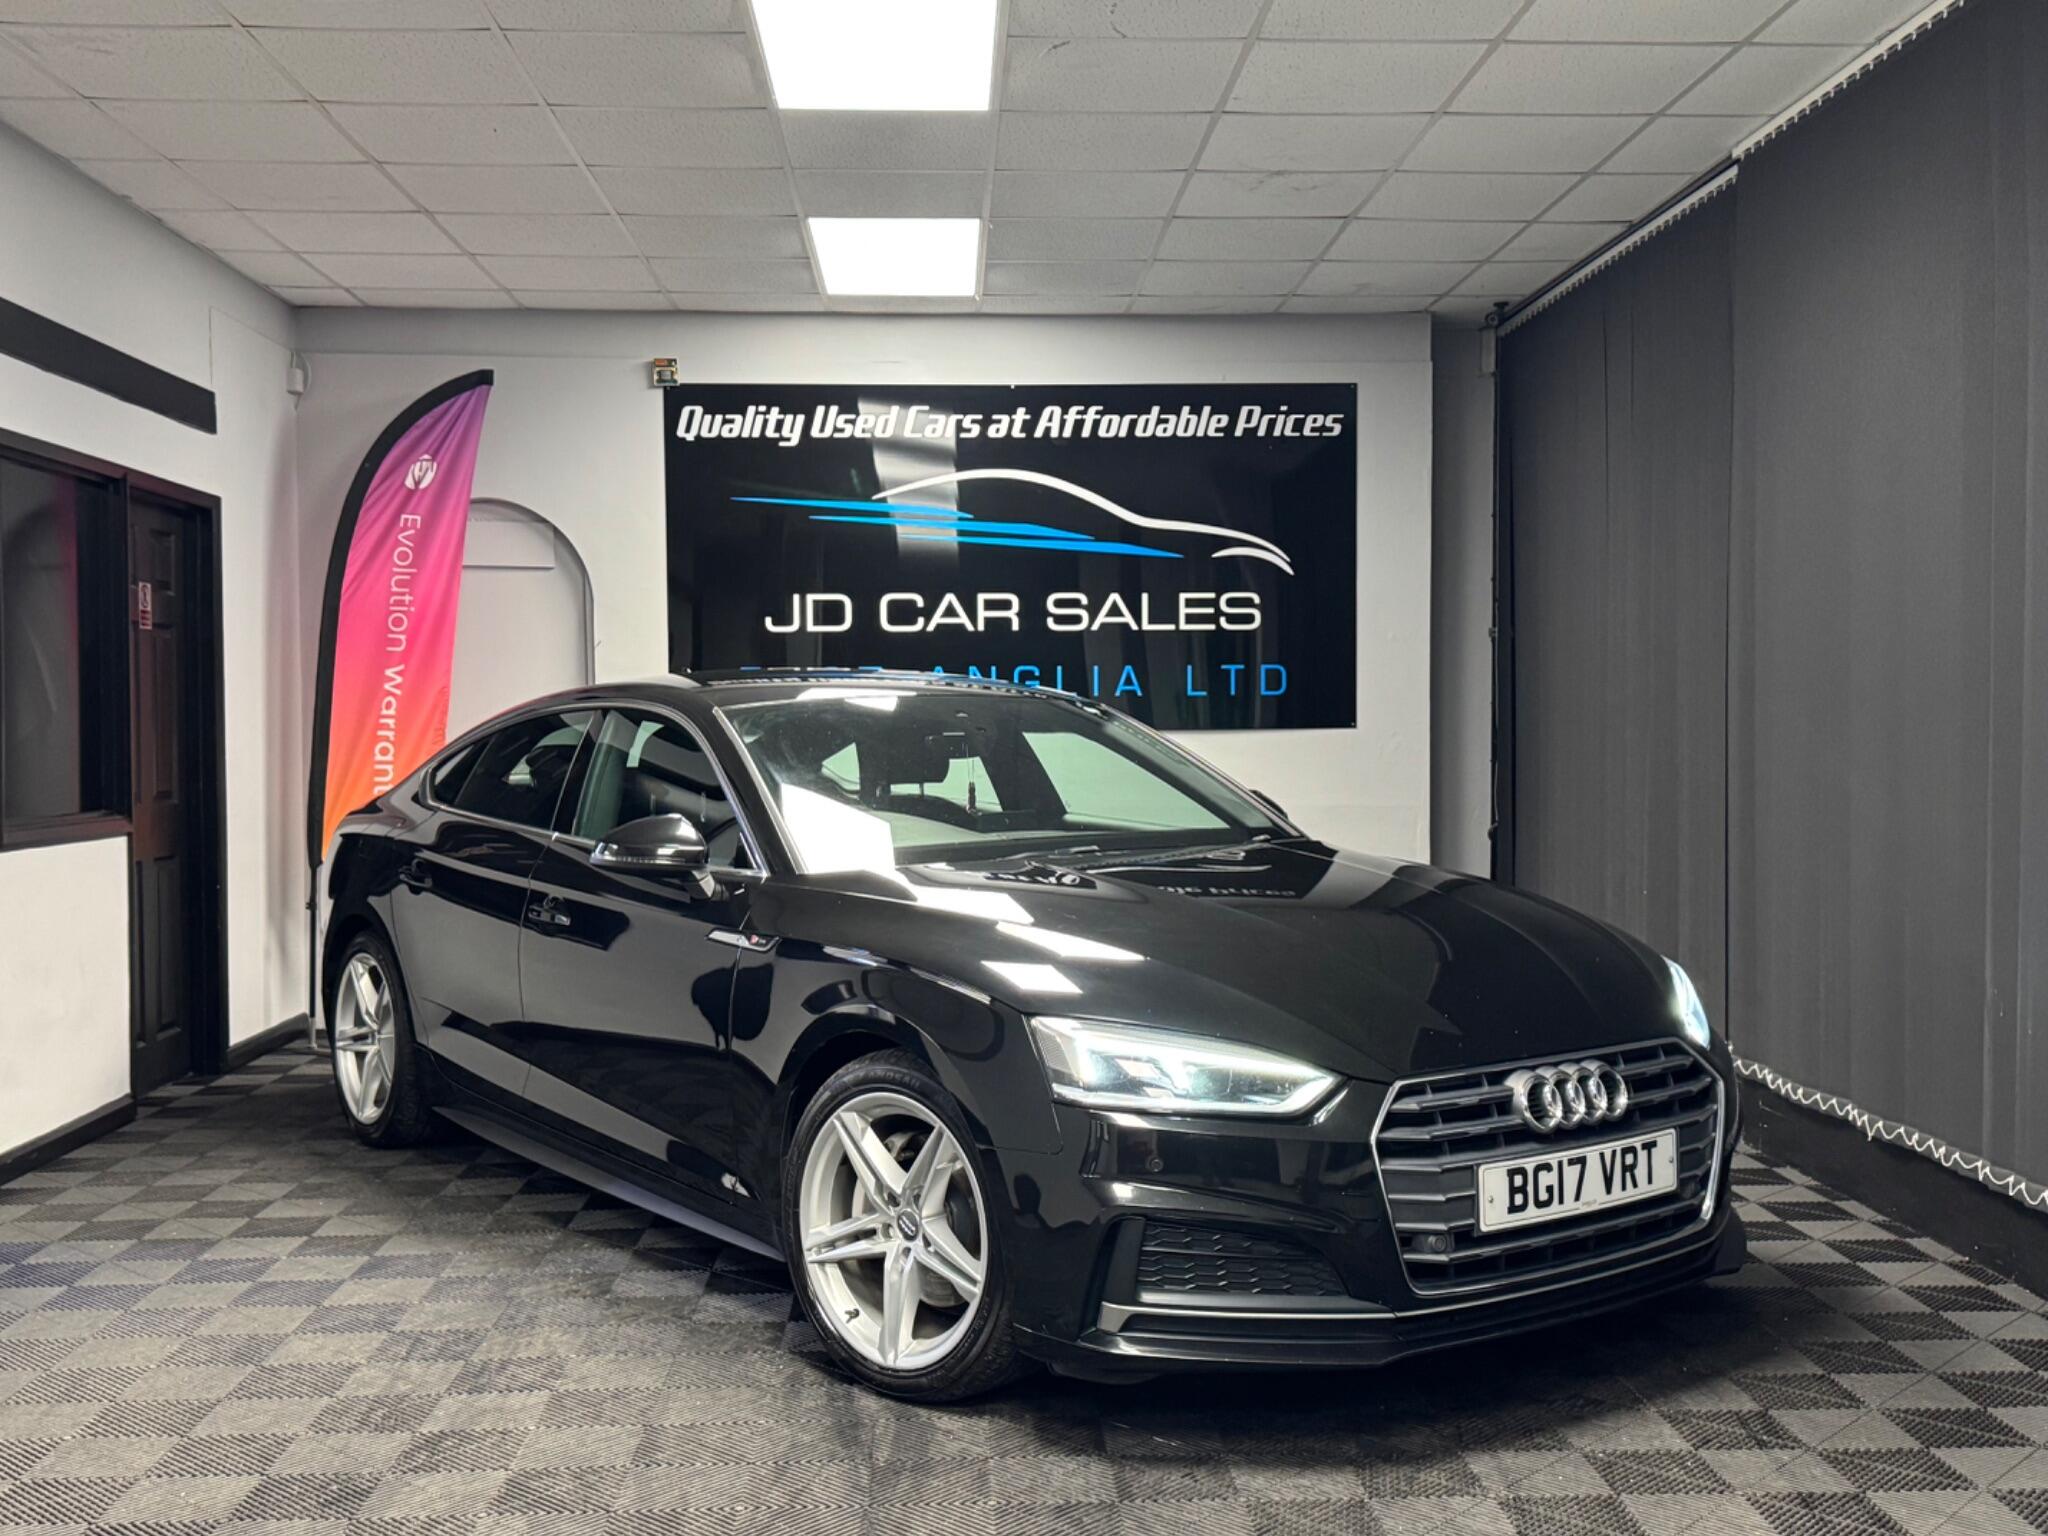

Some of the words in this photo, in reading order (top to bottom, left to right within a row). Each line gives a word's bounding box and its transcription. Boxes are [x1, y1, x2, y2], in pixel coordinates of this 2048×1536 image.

[676, 405, 806, 447] Quality
[810, 405, 900, 439] Used
[903, 405, 982, 439] Cars
[987, 406, 1032, 439] at
[1033, 405, 1229, 439] Affordable
[1235, 405, 1345, 438] Prices
[386, 513, 422, 652] Evolution
[764, 593, 853, 633] JD
[879, 592, 1020, 633] CAR
[1046, 591, 1262, 632] SALES
[1186, 664, 1287, 697] LTD
[1506, 1155, 1588, 1215] BG17
[1599, 1139, 1658, 1196] VRT
